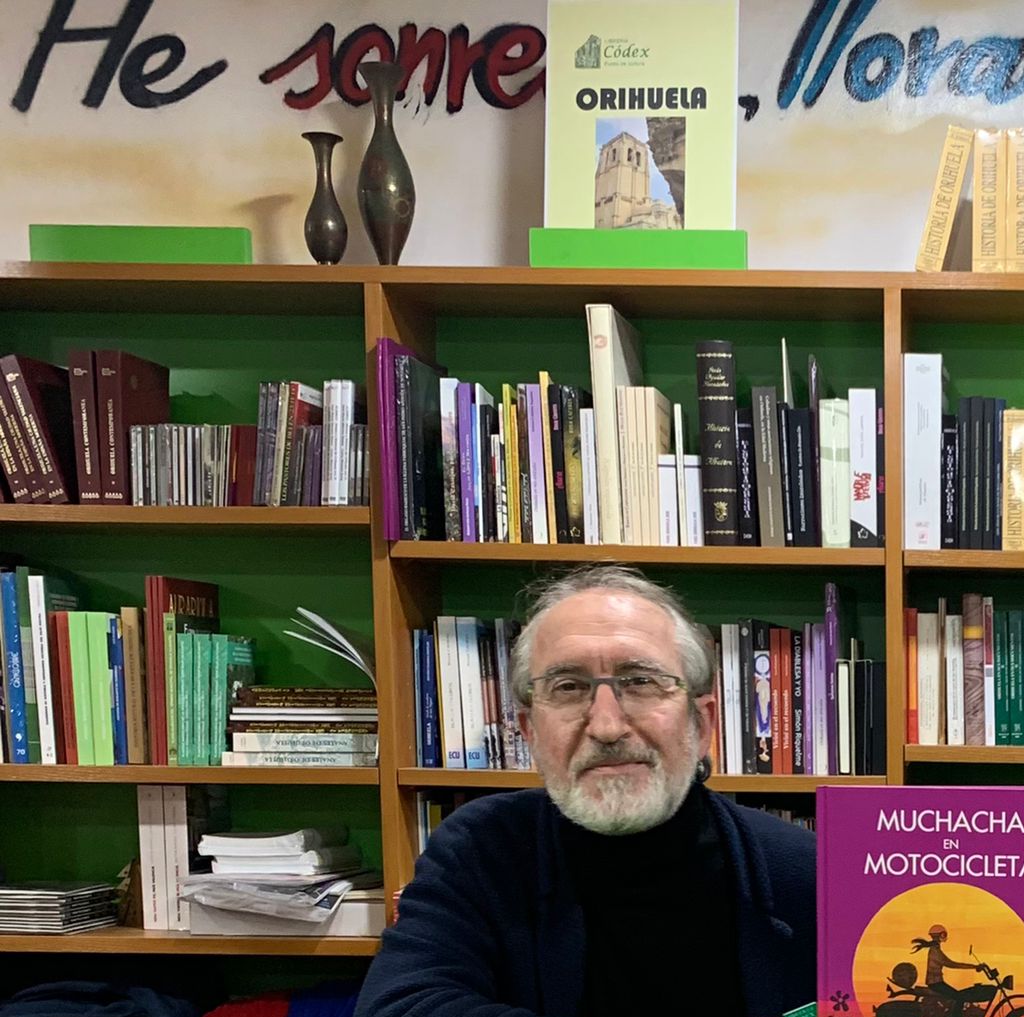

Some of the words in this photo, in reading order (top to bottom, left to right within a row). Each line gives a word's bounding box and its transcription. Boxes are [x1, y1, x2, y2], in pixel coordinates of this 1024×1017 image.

[12, 0, 228, 112] He
[604, 43, 650, 58] Códex
[576, 87, 707, 111] ORIHUELA
[794, 635, 800, 645] LA
[794, 686, 801, 696] YO
[794, 708, 802, 731] Simón
[448, 751, 460, 759] ECU
[468, 751, 480, 760] ECU
[793, 732, 801, 766] Riquelme
[943, 838, 959, 850] EN
